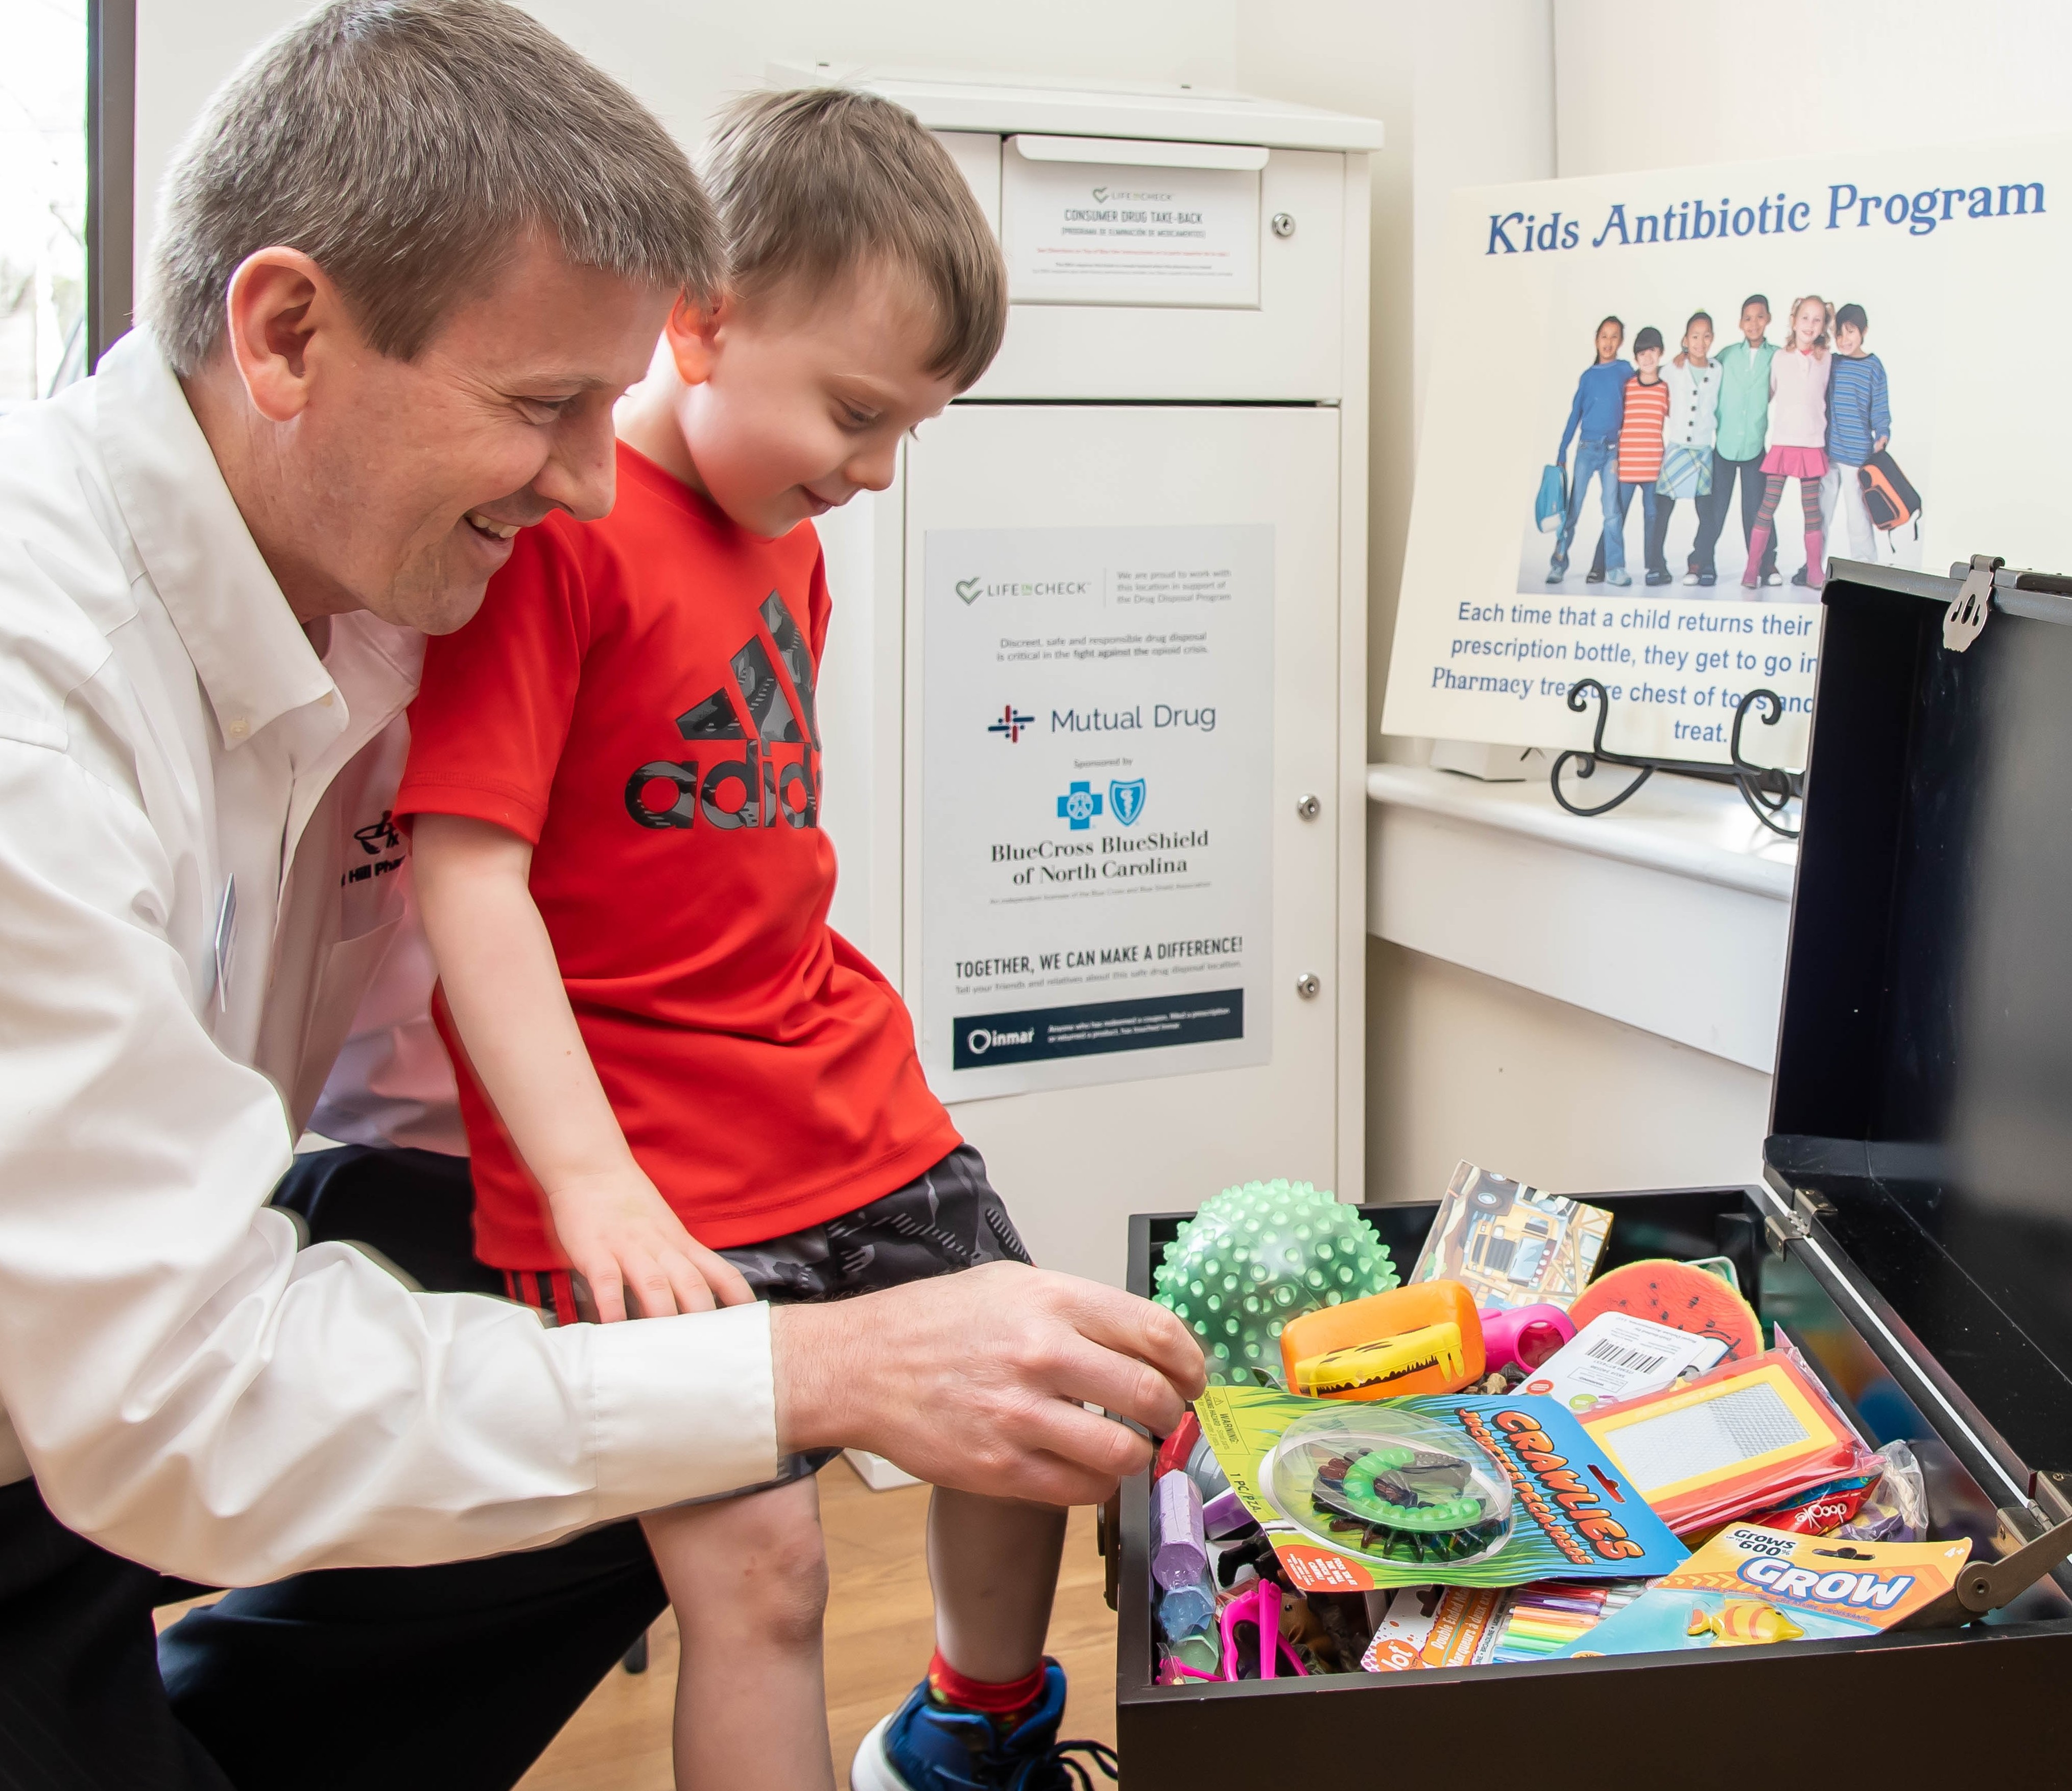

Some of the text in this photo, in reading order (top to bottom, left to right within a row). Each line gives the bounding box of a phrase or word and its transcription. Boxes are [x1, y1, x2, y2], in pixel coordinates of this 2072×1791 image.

[1064, 209, 1203, 224] CONSUMER DRUG TAKE-BACK
[1485, 181, 2046, 255] Kids Antibiotic Program
[987, 583, 1019, 598] LIFE
[1034, 581, 1087, 596] CHECK
[1458, 601, 1813, 637] Each time that a child returns their
[1450, 637, 1567, 663] prescription
[1574, 639, 1637, 667] bottle,
[1644, 644, 1689, 672] they
[1695, 647, 1729, 673] get
[1736, 650, 1756, 670] to
[1764, 655, 1792, 677] go
[1431, 666, 1535, 701] Pharmacy
[1629, 682, 1687, 705] chest
[1693, 686, 1716, 707] of
[1721, 688, 1768, 714] tos
[1051, 703, 1217, 734] Mutual Drug
[1674, 720, 1727, 743] treat.
[625, 739, 824, 830] adid
[991, 830, 1209, 863] BlueCross BlueShield
[1013, 857, 1188, 886] of North Carolina
[956, 935, 1243, 979] TOGETHER, WE CAN MAKE A DIFFERENCE!
[1233, 1480, 1262, 1513] PC/PZA.
[1454, 1407, 1595, 1565] JUGUETES PEGAJOSOS
[1490, 1410, 1646, 1560] CRAWLIES
[1943, 1546, 1966, 1558] 4+
[1741, 1558, 1913, 1608] GROW
[1442, 1598, 1464, 1625] Ended
[1468, 1621, 1479, 1630] à
[1471, 1605, 1488, 1624] deux
[1431, 1623, 1454, 1651] Double
[1446, 1627, 1477, 1667] Marqueurs
